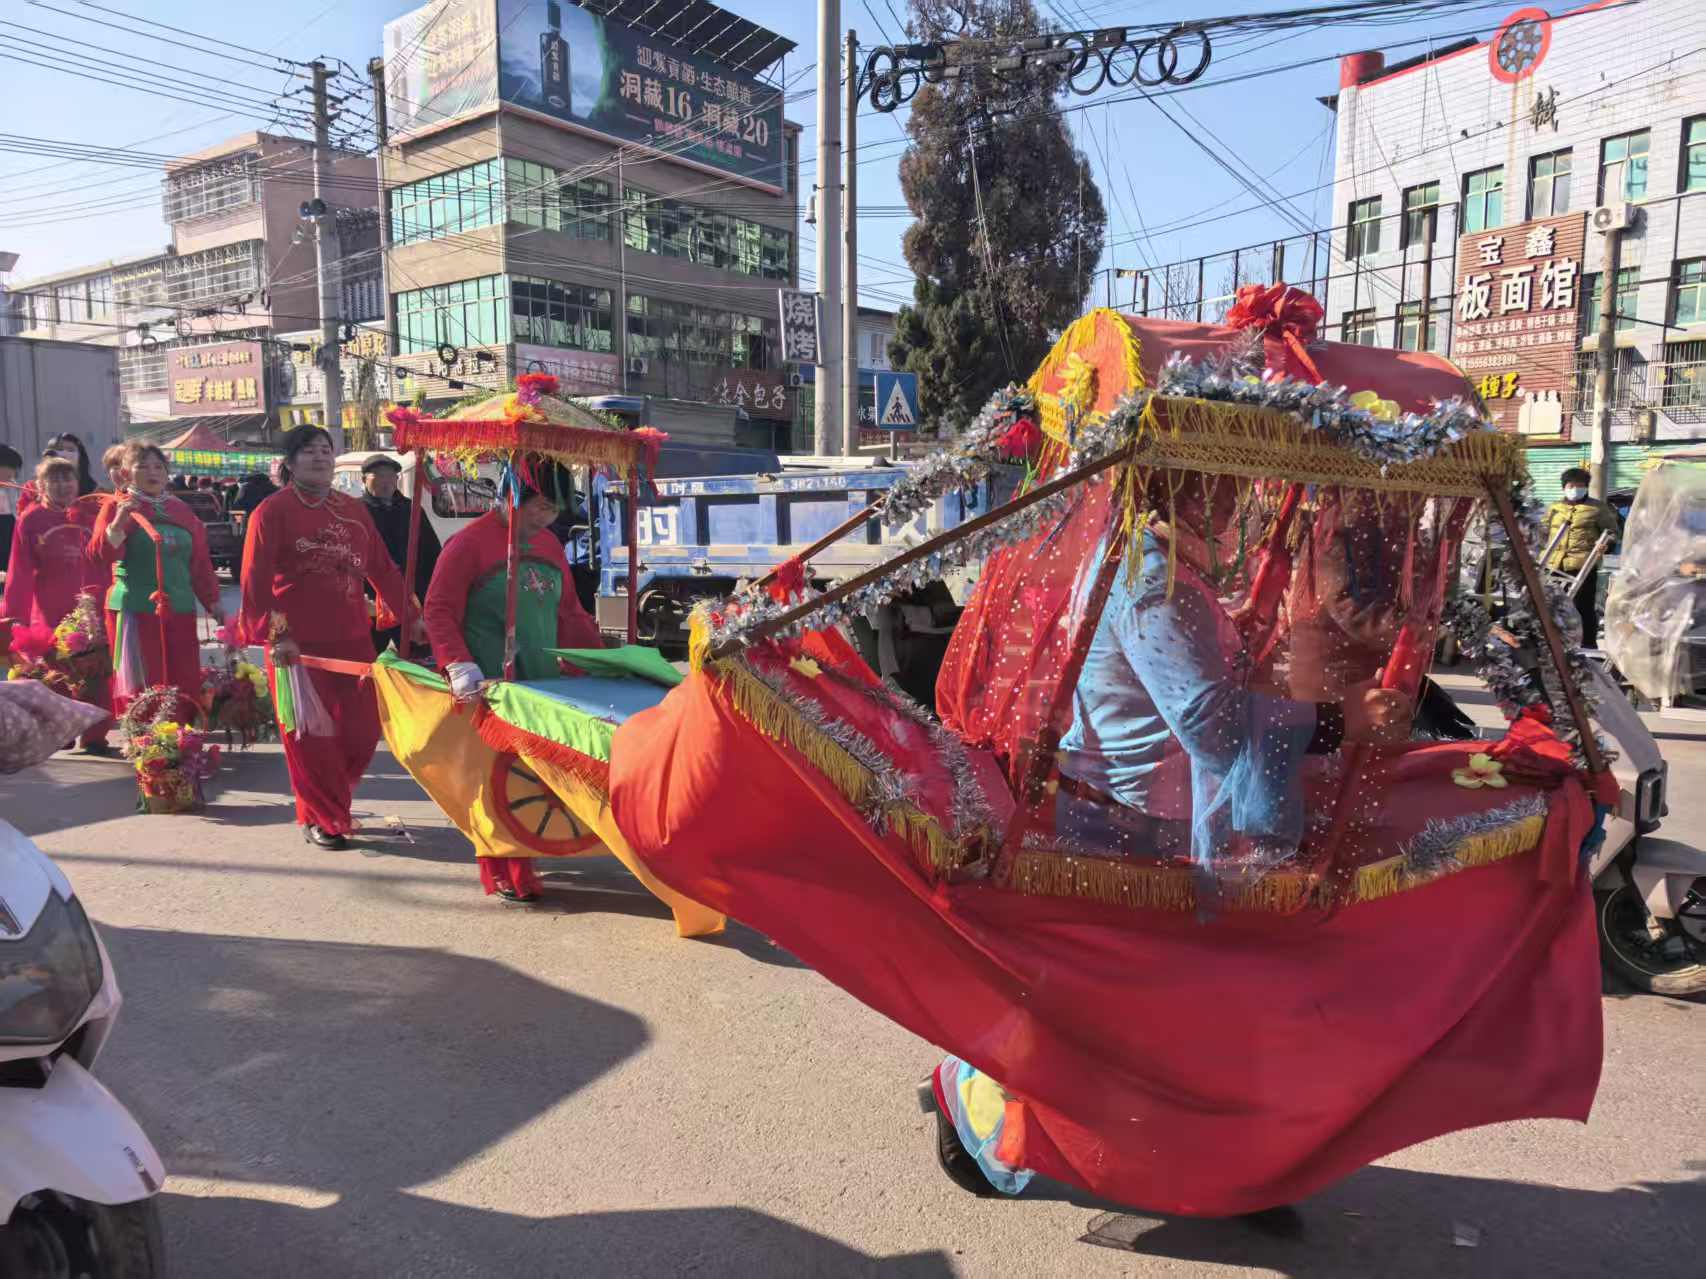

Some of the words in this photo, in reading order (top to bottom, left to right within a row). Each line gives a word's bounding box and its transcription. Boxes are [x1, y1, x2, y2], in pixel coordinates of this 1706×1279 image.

[1478, 225, 1555, 267] 宝鑫
[1458, 256, 1577, 321] 板面馆
[784, 293, 817, 360] 烧烤
